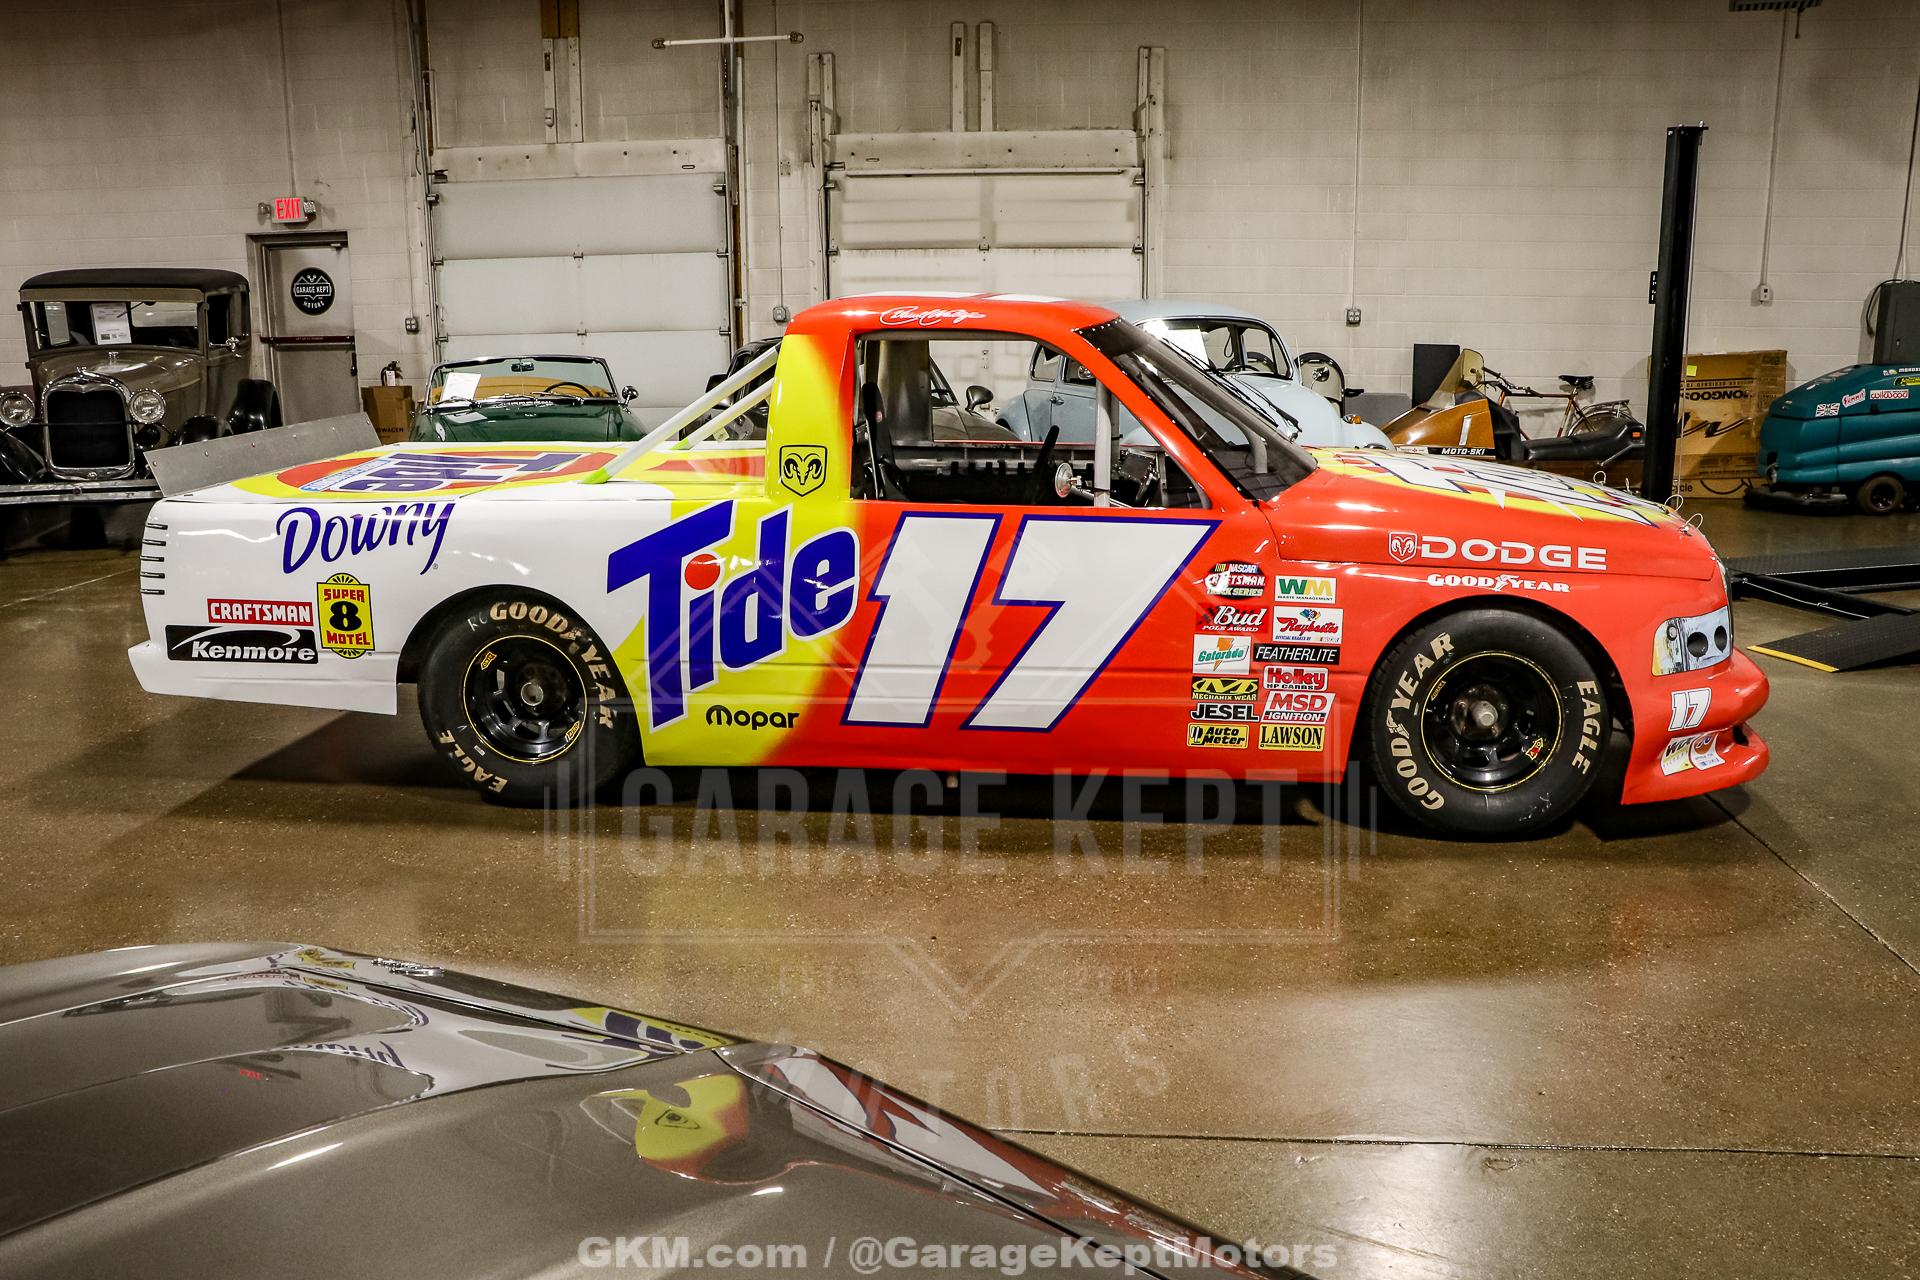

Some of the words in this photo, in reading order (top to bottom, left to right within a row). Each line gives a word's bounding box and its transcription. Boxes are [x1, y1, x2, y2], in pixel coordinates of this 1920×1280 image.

[275, 198, 301, 220] EXIT
[316, 285, 329, 293] KEPT
[1441, 448, 1486, 456] MOTO-SKI
[276, 502, 456, 575] Downy
[1421, 535, 1607, 570] DODGE
[1228, 562, 1258, 574] NASCAR
[323, 588, 366, 603] SUPER
[1233, 587, 1264, 597] SERIES
[1278, 578, 1333, 597] WM
[210, 602, 312, 623] CRAFTSMAN
[329, 600, 363, 632] 8
[606, 499, 860, 730] Tide
[841, 511, 1222, 733] 17
[1213, 604, 1268, 626] Bud
[326, 630, 371, 646] MOTEL
[1202, 624, 1227, 632] POLE
[1227, 625, 1259, 633] AWARD
[191, 640, 316, 662] Kenmore
[1198, 647, 1245, 662] Gatorade
[1255, 645, 1338, 662] FEATHERLITE
[1267, 668, 1326, 690] Holley
[1191, 692, 1233, 700] MECHANIX
[1234, 692, 1258, 701] WEAR
[1269, 692, 1328, 712] MSD
[705, 704, 800, 731] Mopar
[1190, 703, 1260, 721] JESEL
[1268, 712, 1322, 722] IGNITION
[1667, 687, 1712, 732] 17
[1204, 726, 1240, 736] Auto
[1260, 725, 1323, 746] LAWSON
[1571, 680, 1602, 775] EAGLE
[1203, 735, 1246, 745] Meter
[438, 729, 509, 793] EAGLE
